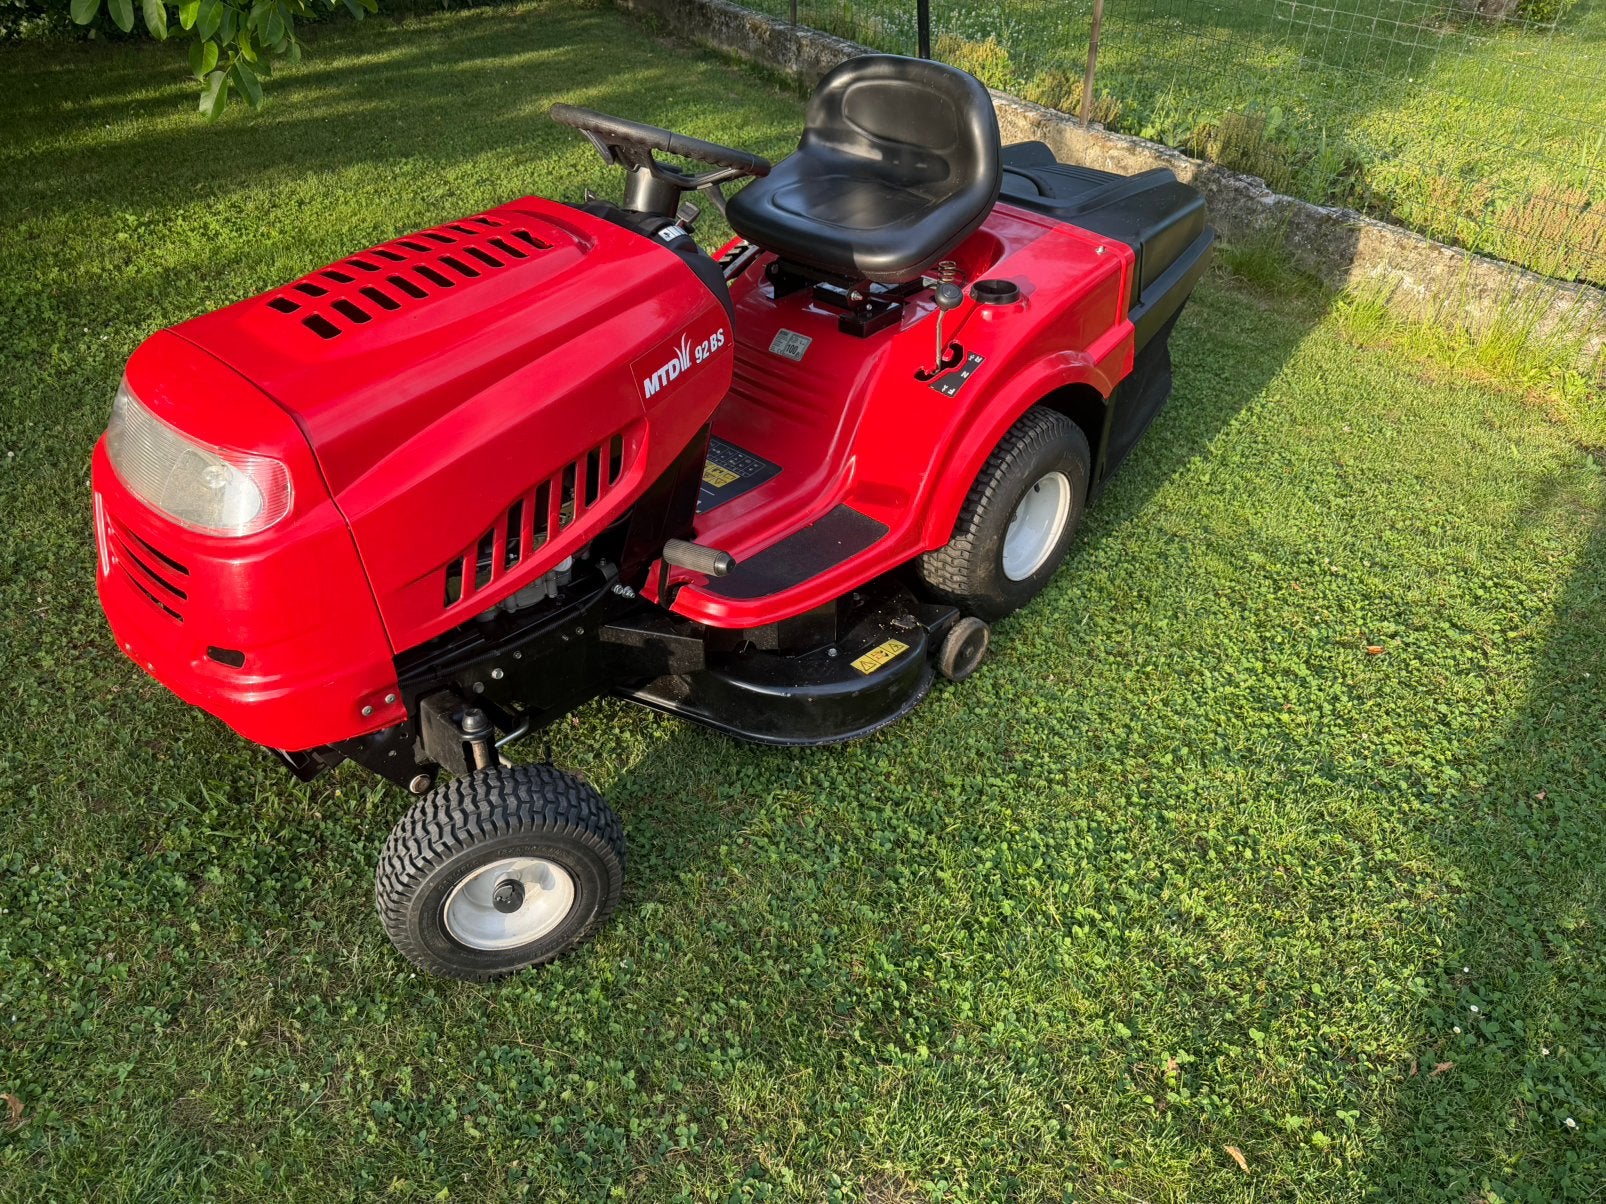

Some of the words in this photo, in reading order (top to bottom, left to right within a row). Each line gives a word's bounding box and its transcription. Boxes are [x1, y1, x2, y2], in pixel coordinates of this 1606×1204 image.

[643, 357, 681, 399] MTD
[694, 339, 710, 364] 92
[709, 328, 725, 353] BS
[960, 370, 969, 379] N
